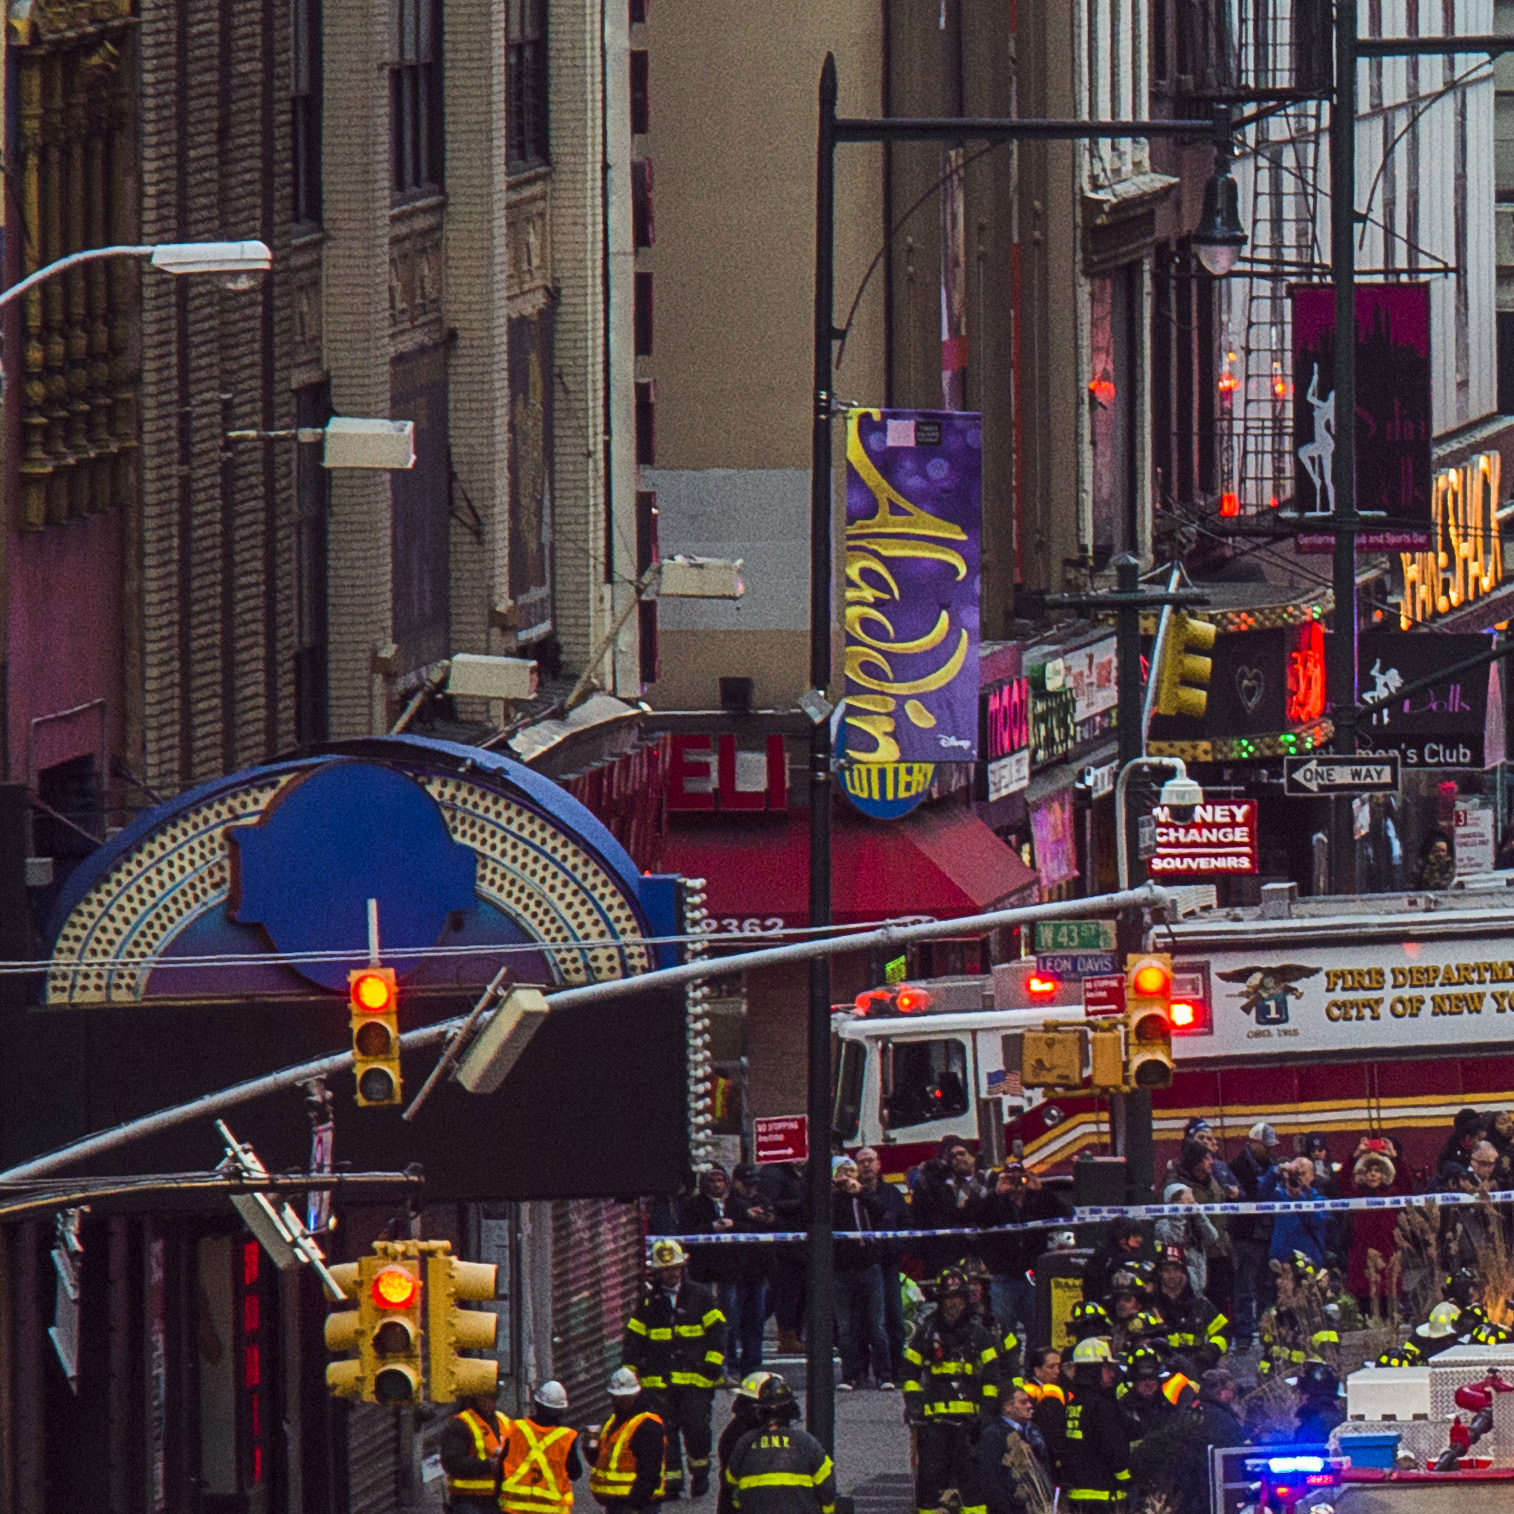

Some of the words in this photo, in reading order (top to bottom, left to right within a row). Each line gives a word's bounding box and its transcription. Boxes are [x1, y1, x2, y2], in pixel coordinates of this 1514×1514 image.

[844, 407, 969, 763] Aladdin
[1423, 745, 1472, 765] Club
[1302, 767, 1337, 784] ONE
[1350, 766, 1384, 784] WAY
[1152, 804, 1252, 823] MNEY
[1155, 826, 1250, 843] CHANGE
[1151, 856, 1251, 871] SOUVENIRS
[1040, 925, 1056, 947] W
[1057, 924, 1079, 946] 43
[1039, 957, 1073, 975] LEON
[1076, 955, 1114, 973] DAVIS
[1324, 967, 1386, 993] FIRE
[1266, 1001, 1281, 1020] 1
[1324, 996, 1386, 1023] CITY
[1389, 994, 1426, 1019] OF
[1430, 991, 1487, 1017] NEW
